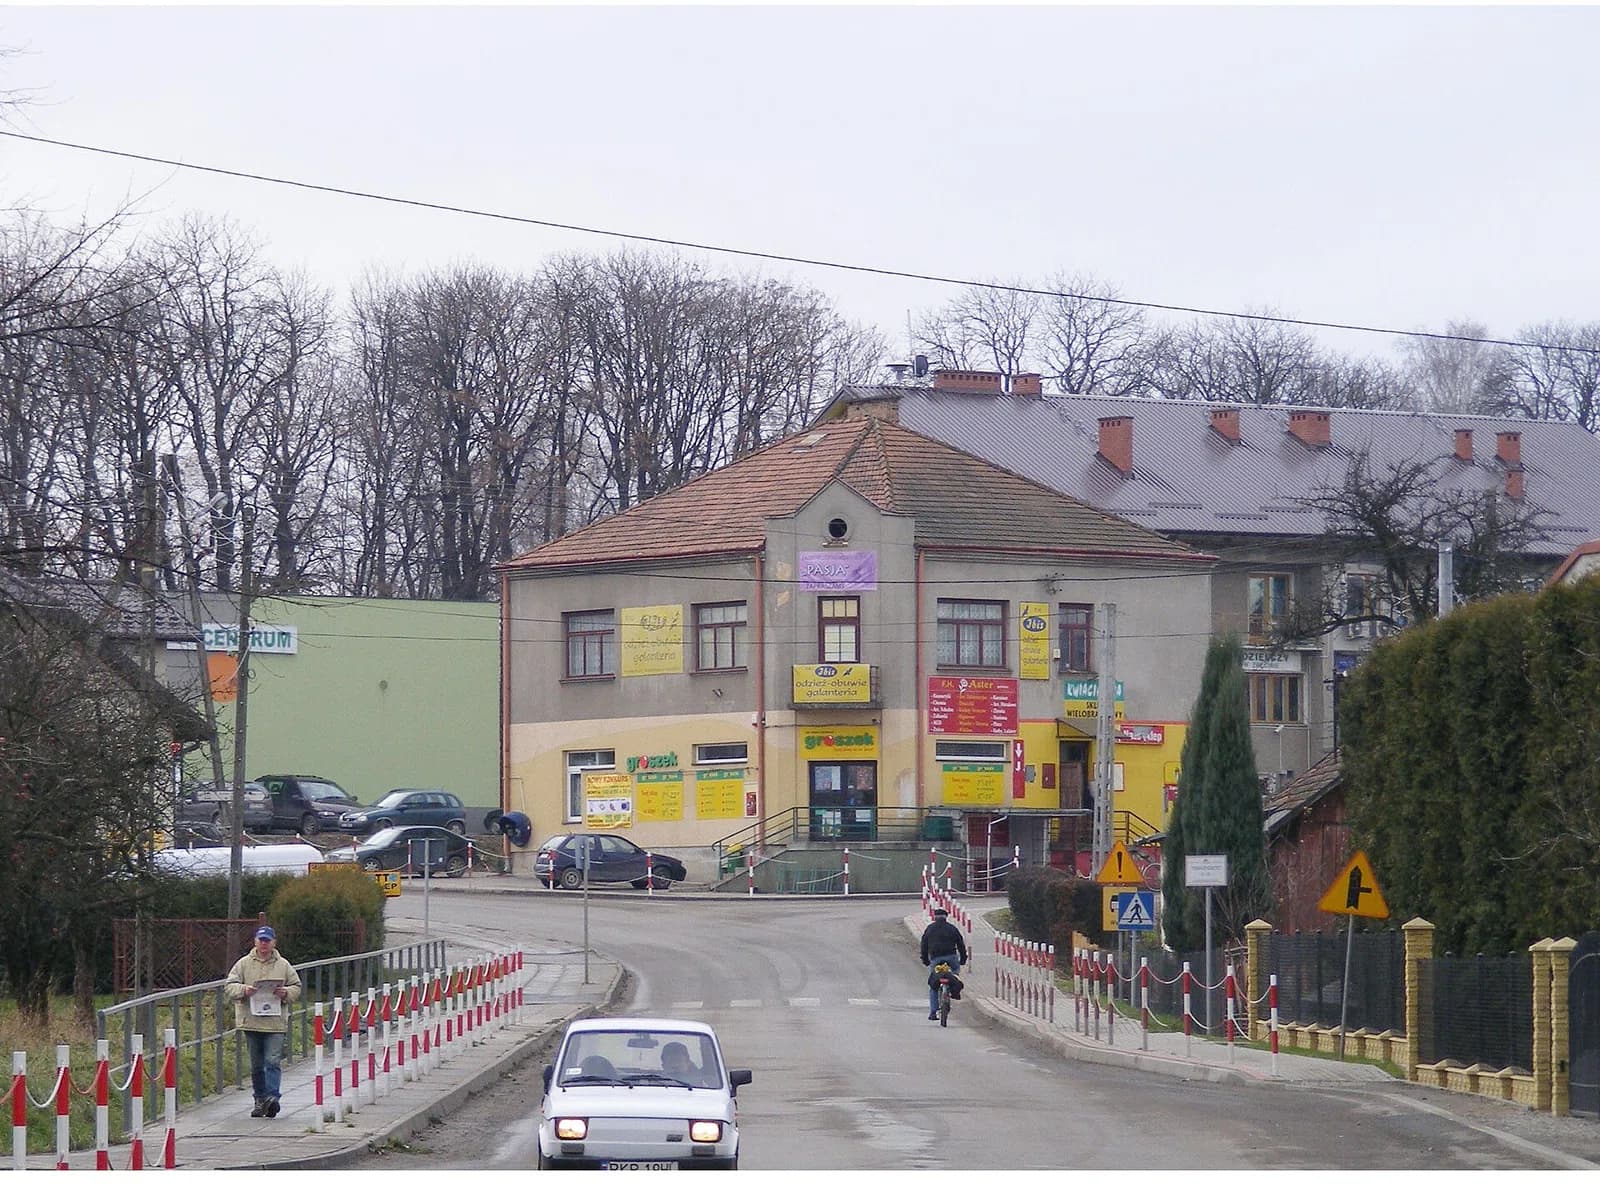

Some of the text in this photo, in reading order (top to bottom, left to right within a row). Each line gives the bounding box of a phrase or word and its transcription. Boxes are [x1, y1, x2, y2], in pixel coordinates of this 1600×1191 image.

[203, 629, 291, 648] CENRUM
[796, 679, 867, 688] odzież-obuwie
[807, 688, 857, 698] galanteria
